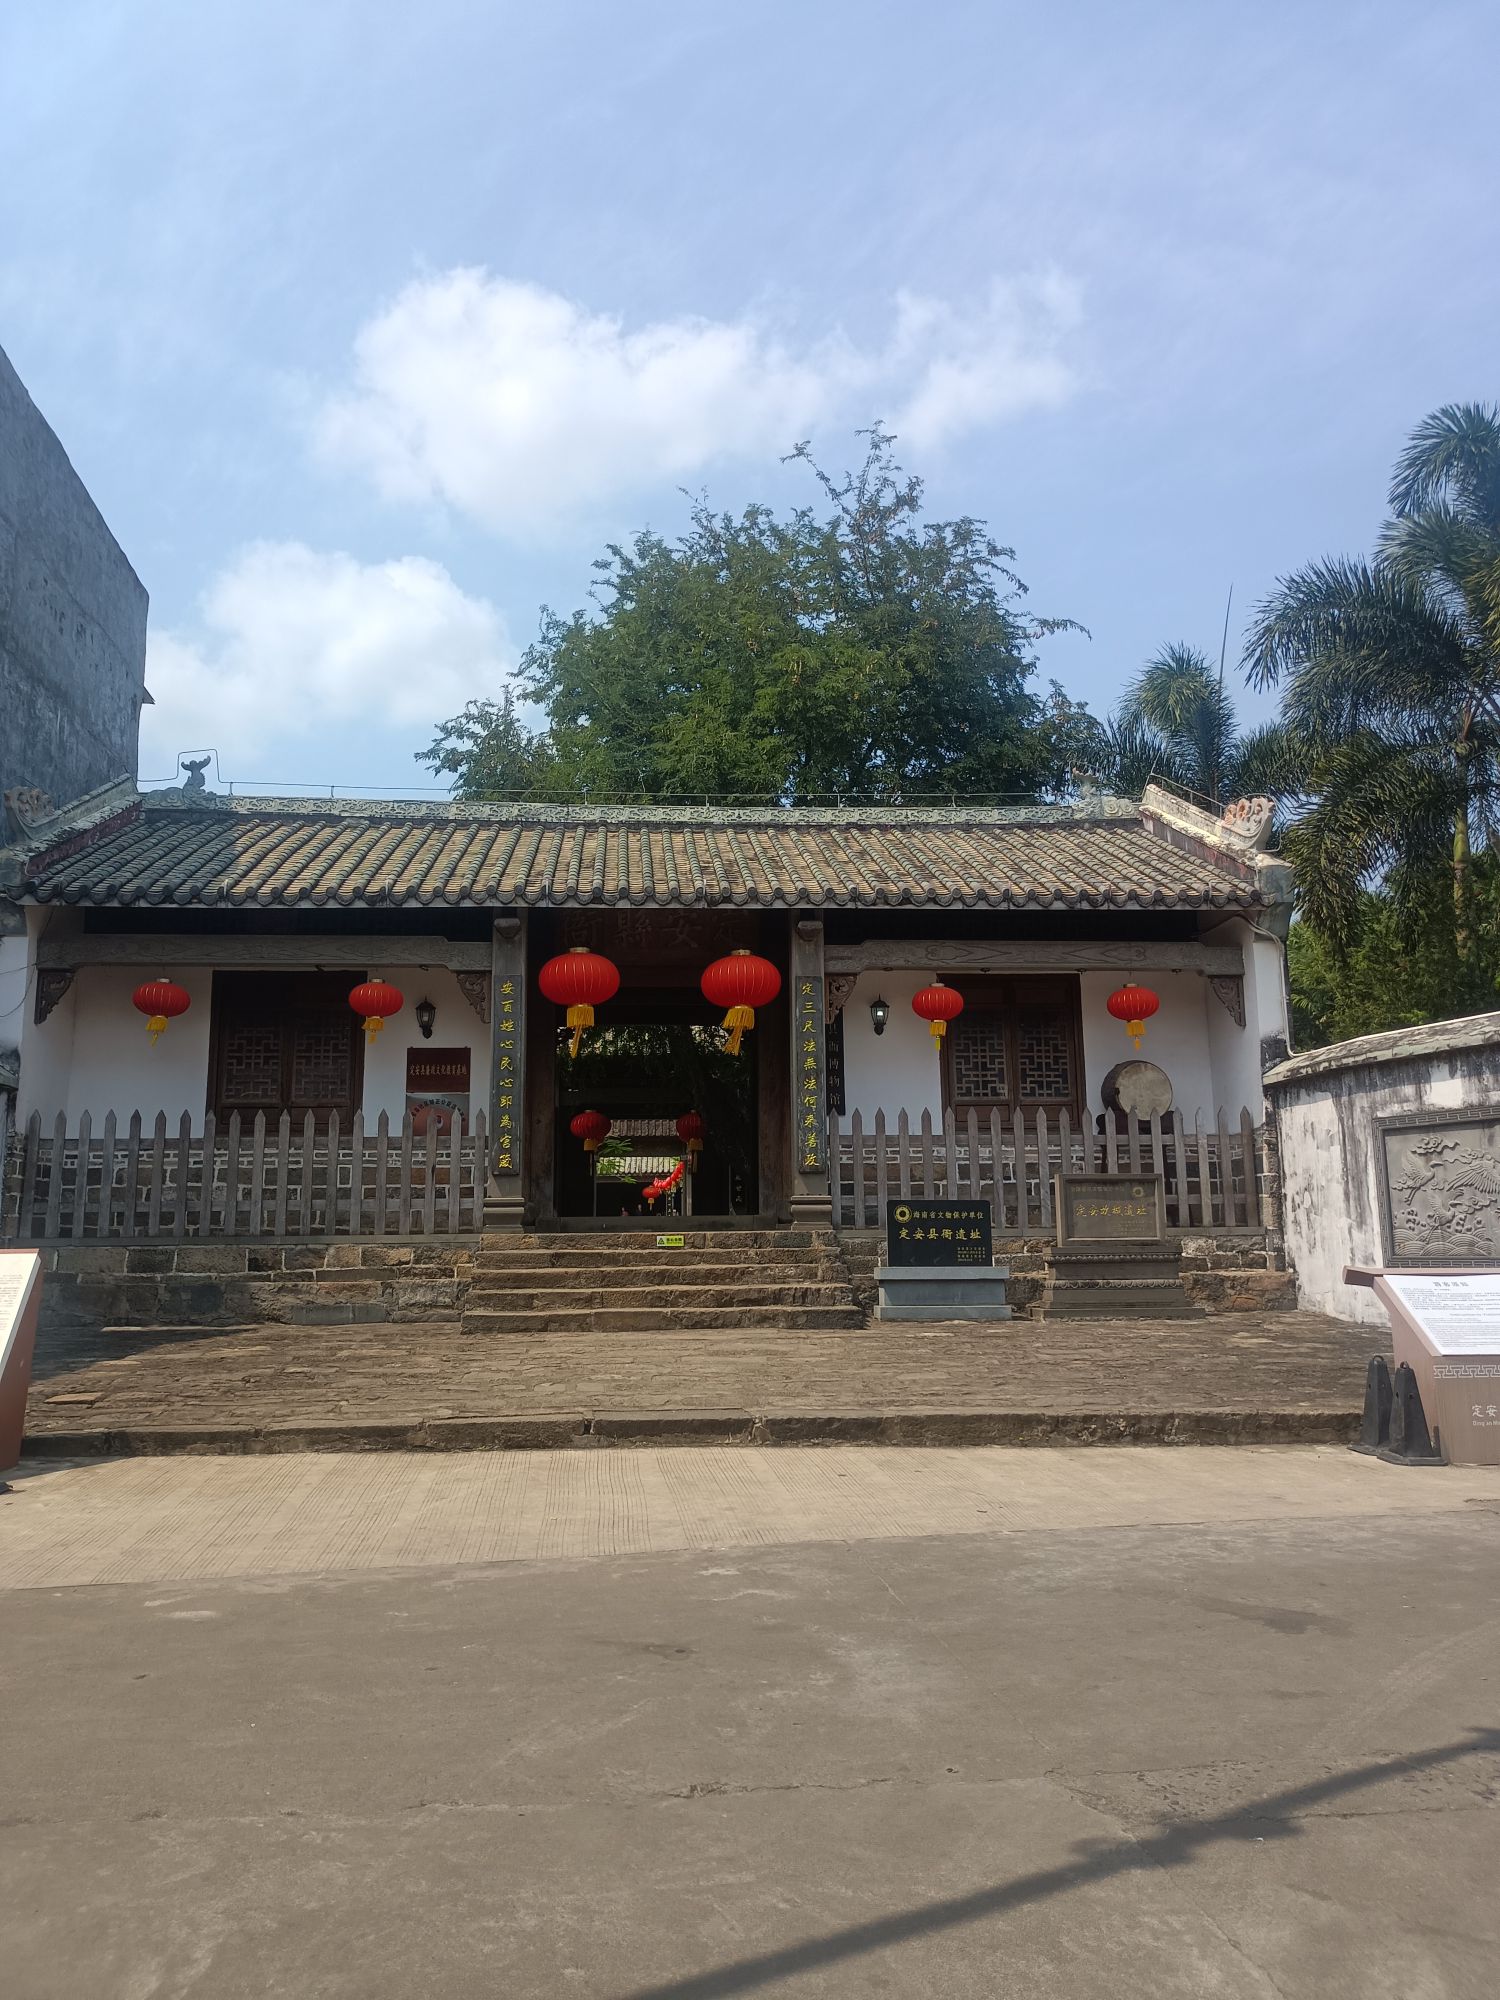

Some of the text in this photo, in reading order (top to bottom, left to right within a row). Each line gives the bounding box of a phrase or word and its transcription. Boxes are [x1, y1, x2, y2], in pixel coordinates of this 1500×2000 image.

[913, 1211, 984, 1219] 海南省文物保护单位
[898, 1227, 982, 1240] 定安县衙遗址
[1471, 1405, 1497, 1418] 定安
